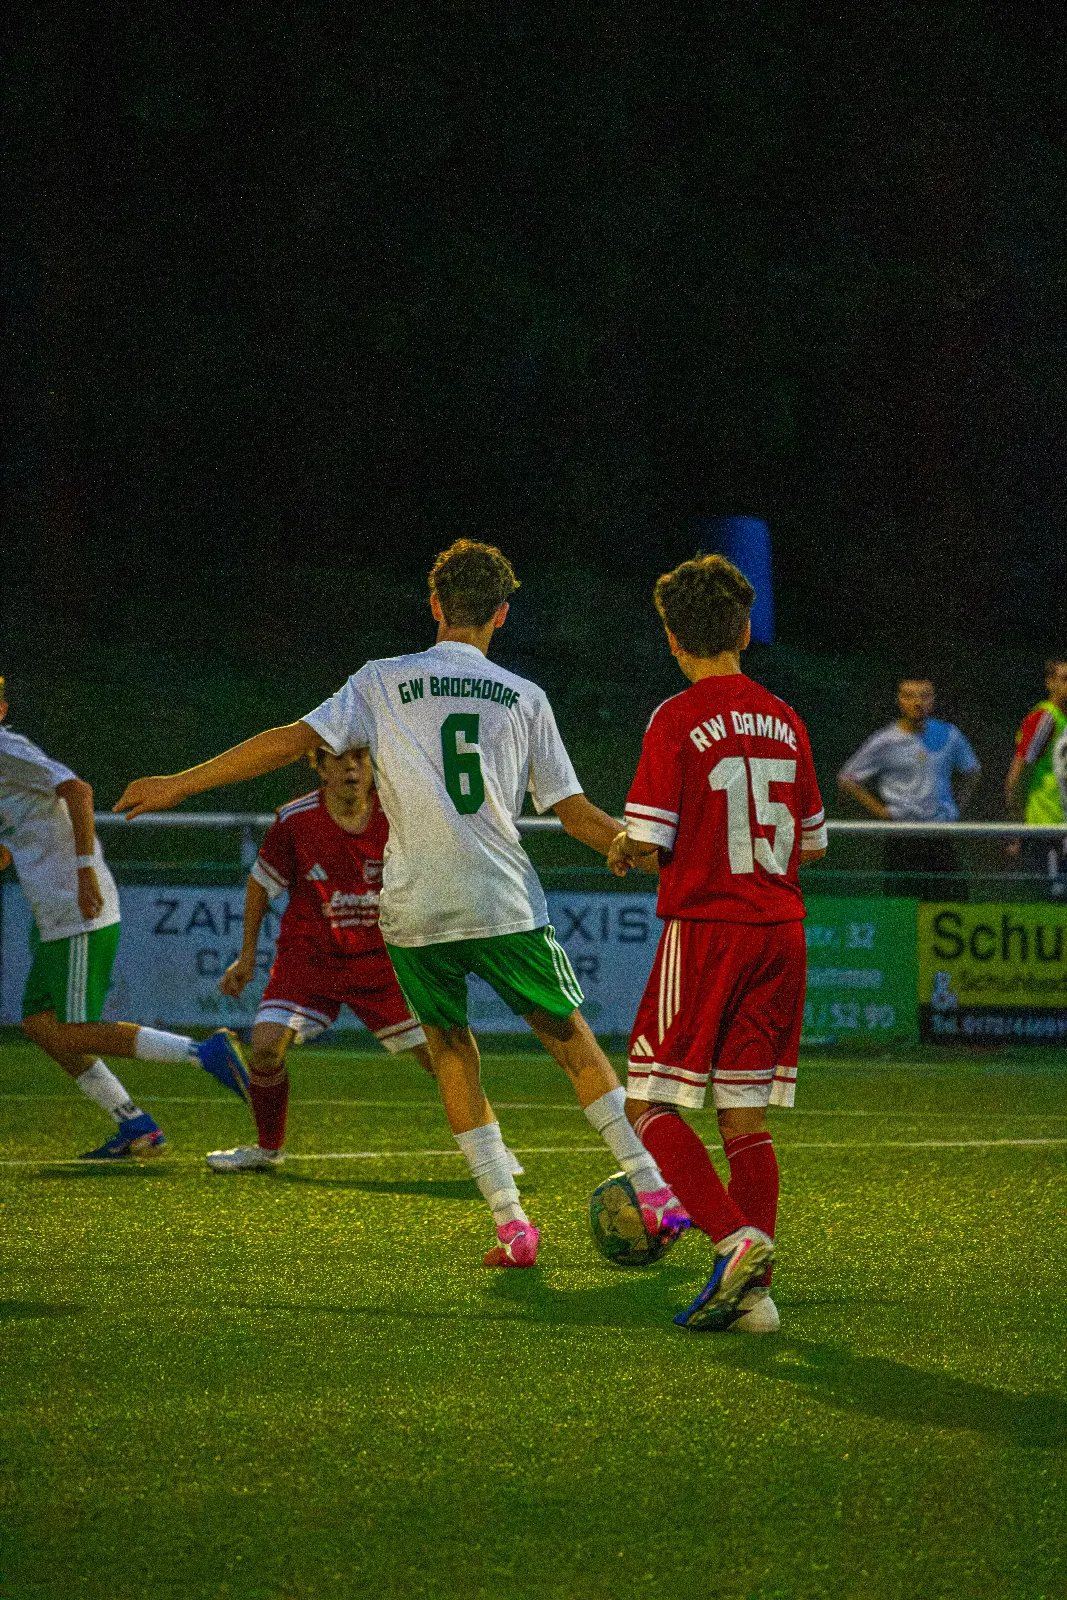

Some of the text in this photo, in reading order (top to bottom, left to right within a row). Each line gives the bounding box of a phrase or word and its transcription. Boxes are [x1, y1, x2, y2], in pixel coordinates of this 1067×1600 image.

[398, 676, 520, 709] GW BROCKDORF
[690, 711, 797, 752] RW DAMME
[440, 713, 486, 815] 6
[708, 756, 797, 875] 15
[933, 911, 1064, 962] Schu
